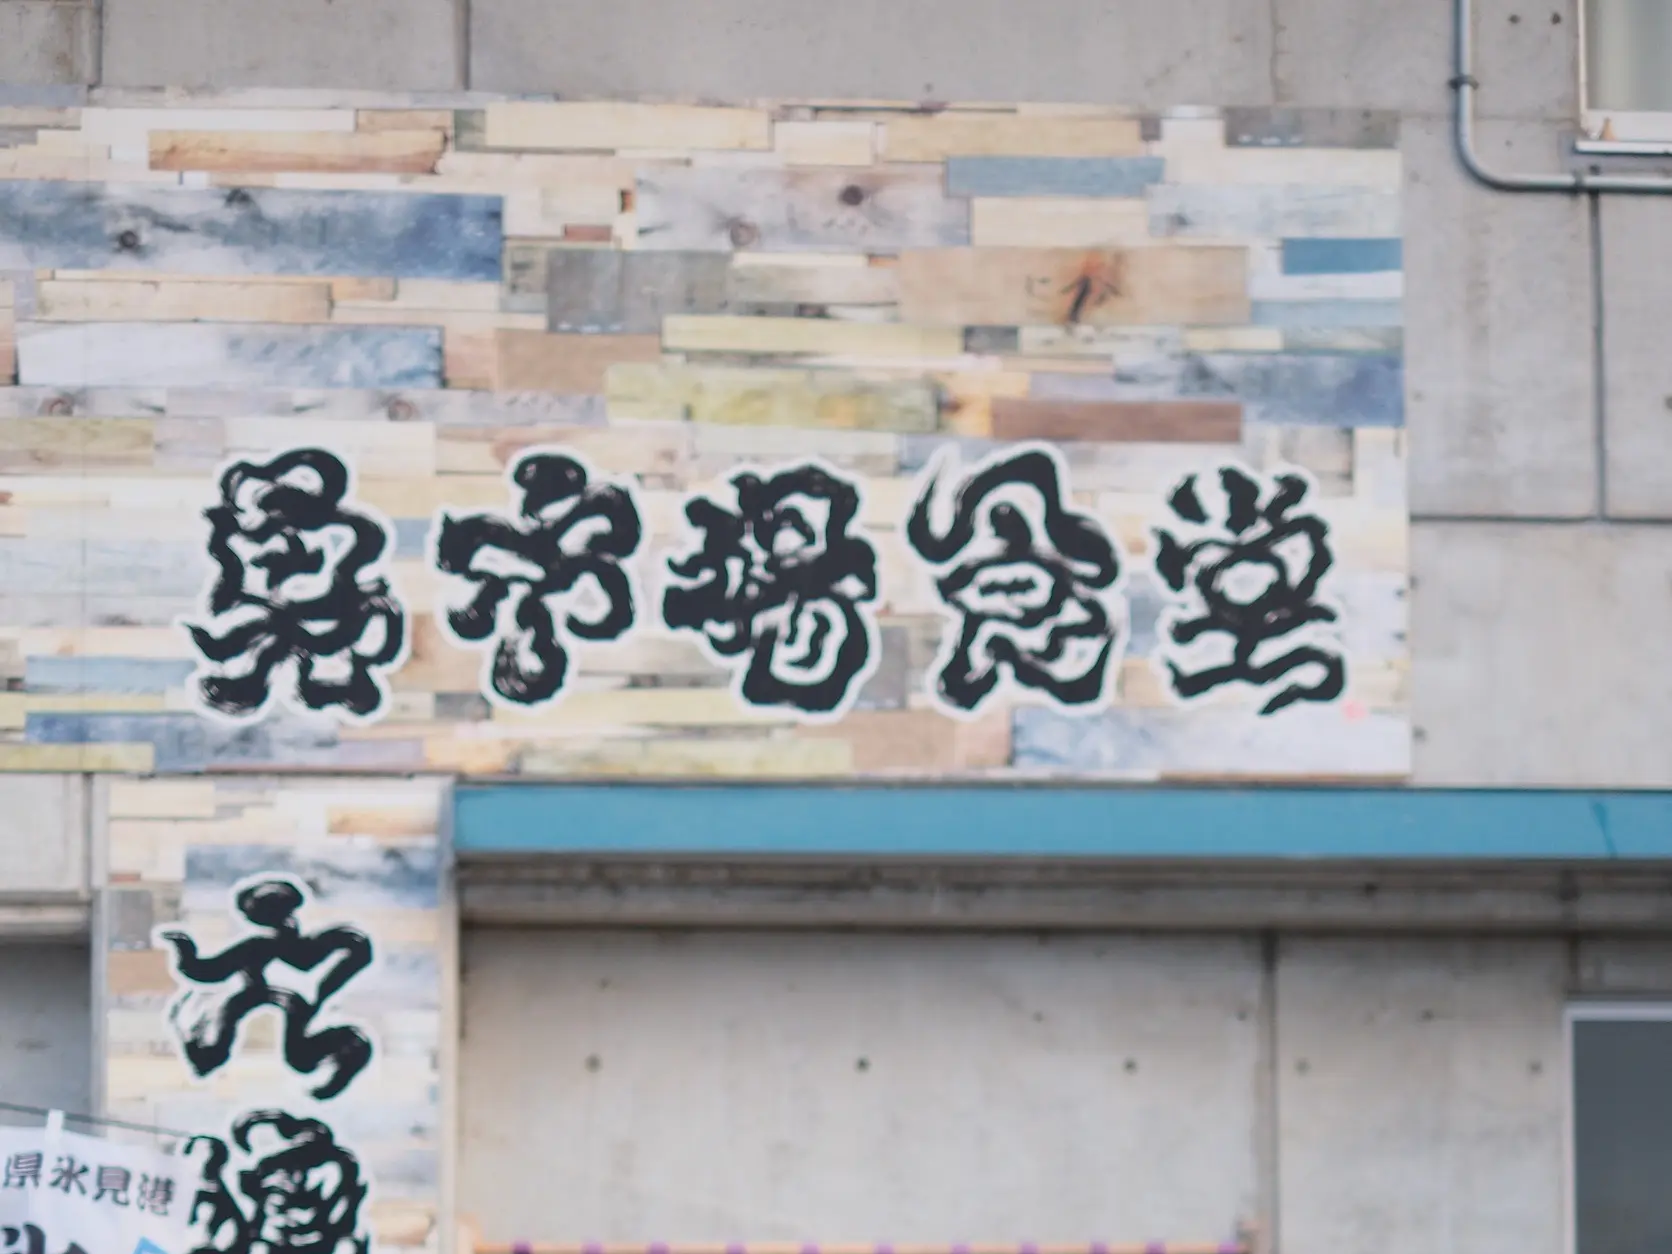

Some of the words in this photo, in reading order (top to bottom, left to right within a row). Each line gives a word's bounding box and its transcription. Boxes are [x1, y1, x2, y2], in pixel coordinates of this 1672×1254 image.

[187, 446, 1347, 716] 魚市場食堂
